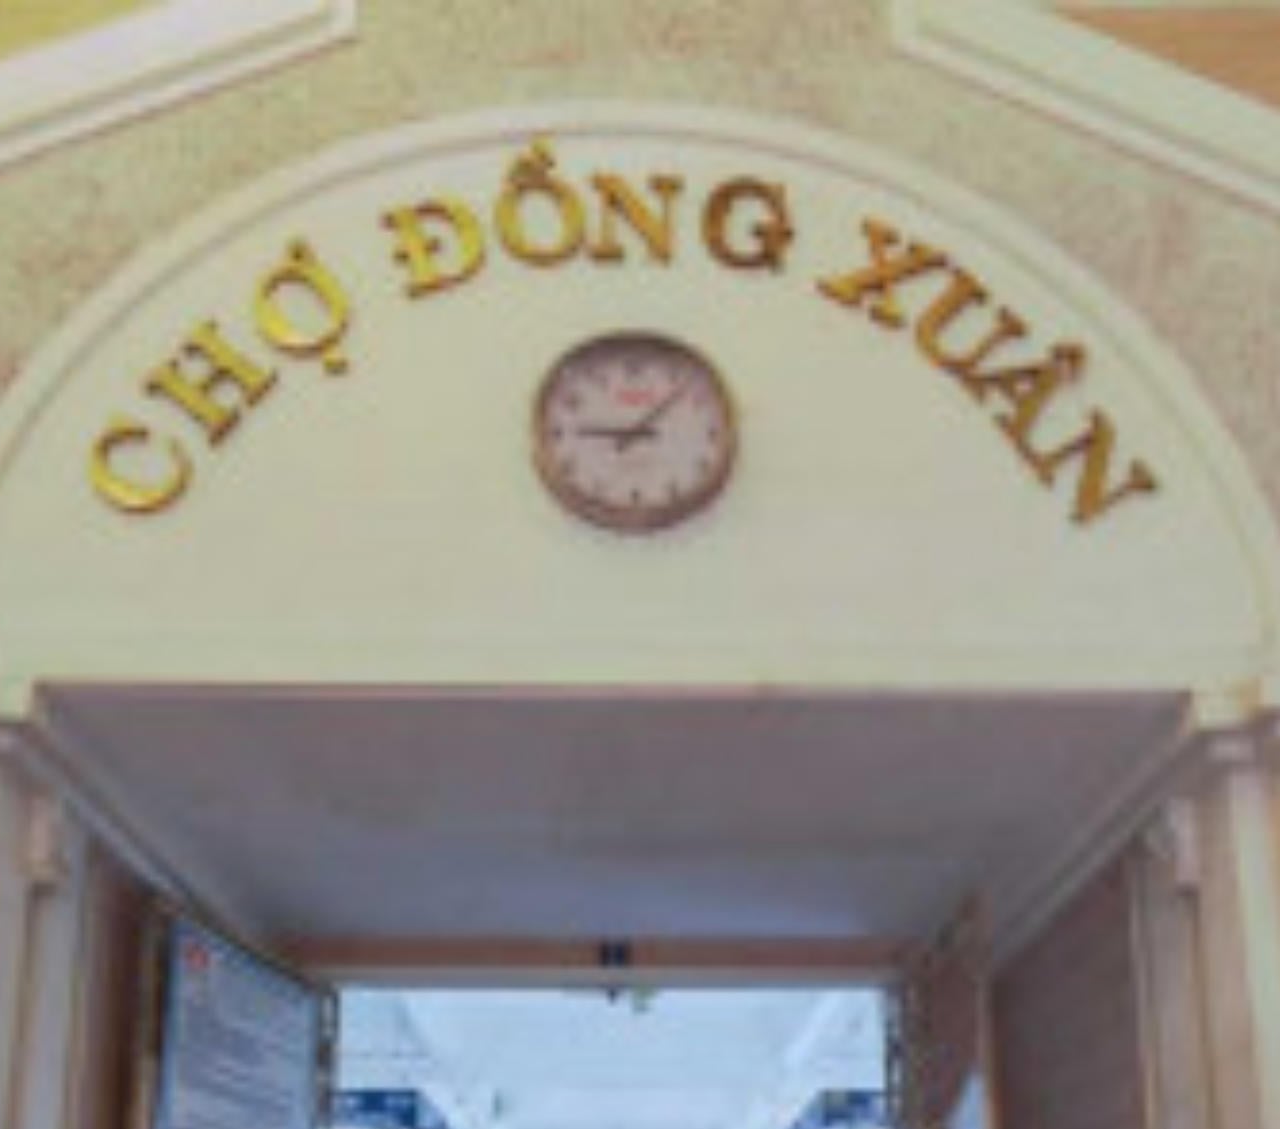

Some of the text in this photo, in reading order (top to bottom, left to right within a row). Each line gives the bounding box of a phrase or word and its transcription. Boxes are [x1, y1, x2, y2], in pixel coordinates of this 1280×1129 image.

[88, 134, 1158, 526] CHỢ ĐỒNG XUÂN
